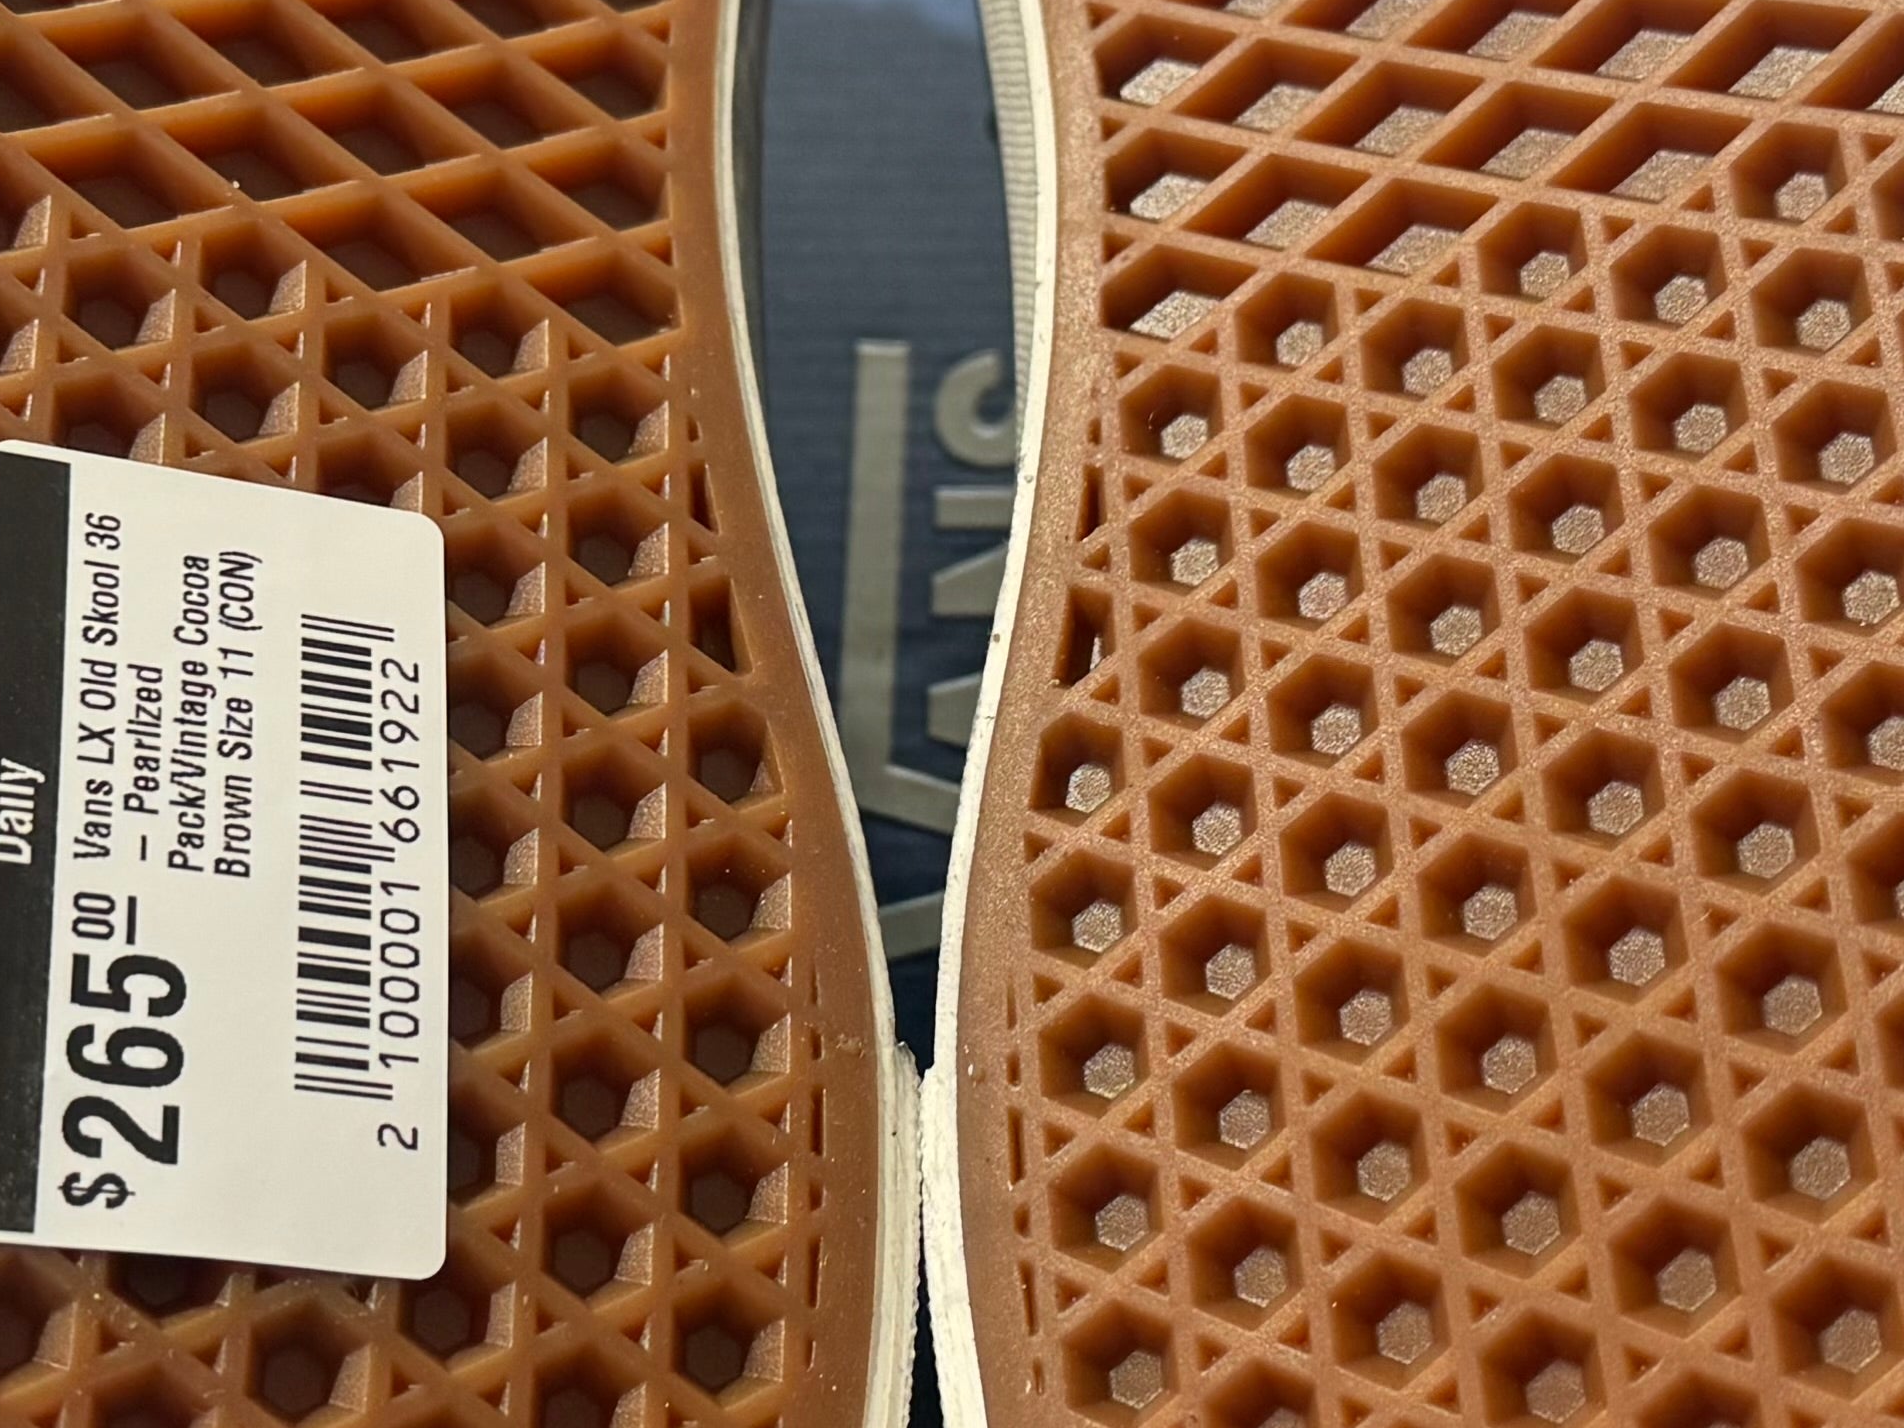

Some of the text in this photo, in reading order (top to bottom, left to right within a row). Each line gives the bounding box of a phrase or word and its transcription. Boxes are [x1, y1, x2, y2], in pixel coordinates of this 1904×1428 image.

[73, 510, 122, 862] Vans LX Old Skool 36
[123, 662, 164, 815] Pearlized
[168, 552, 216, 874] Pack/Vintage Cocoa
[215, 547, 262, 879] Brown Size 11 (CON)
